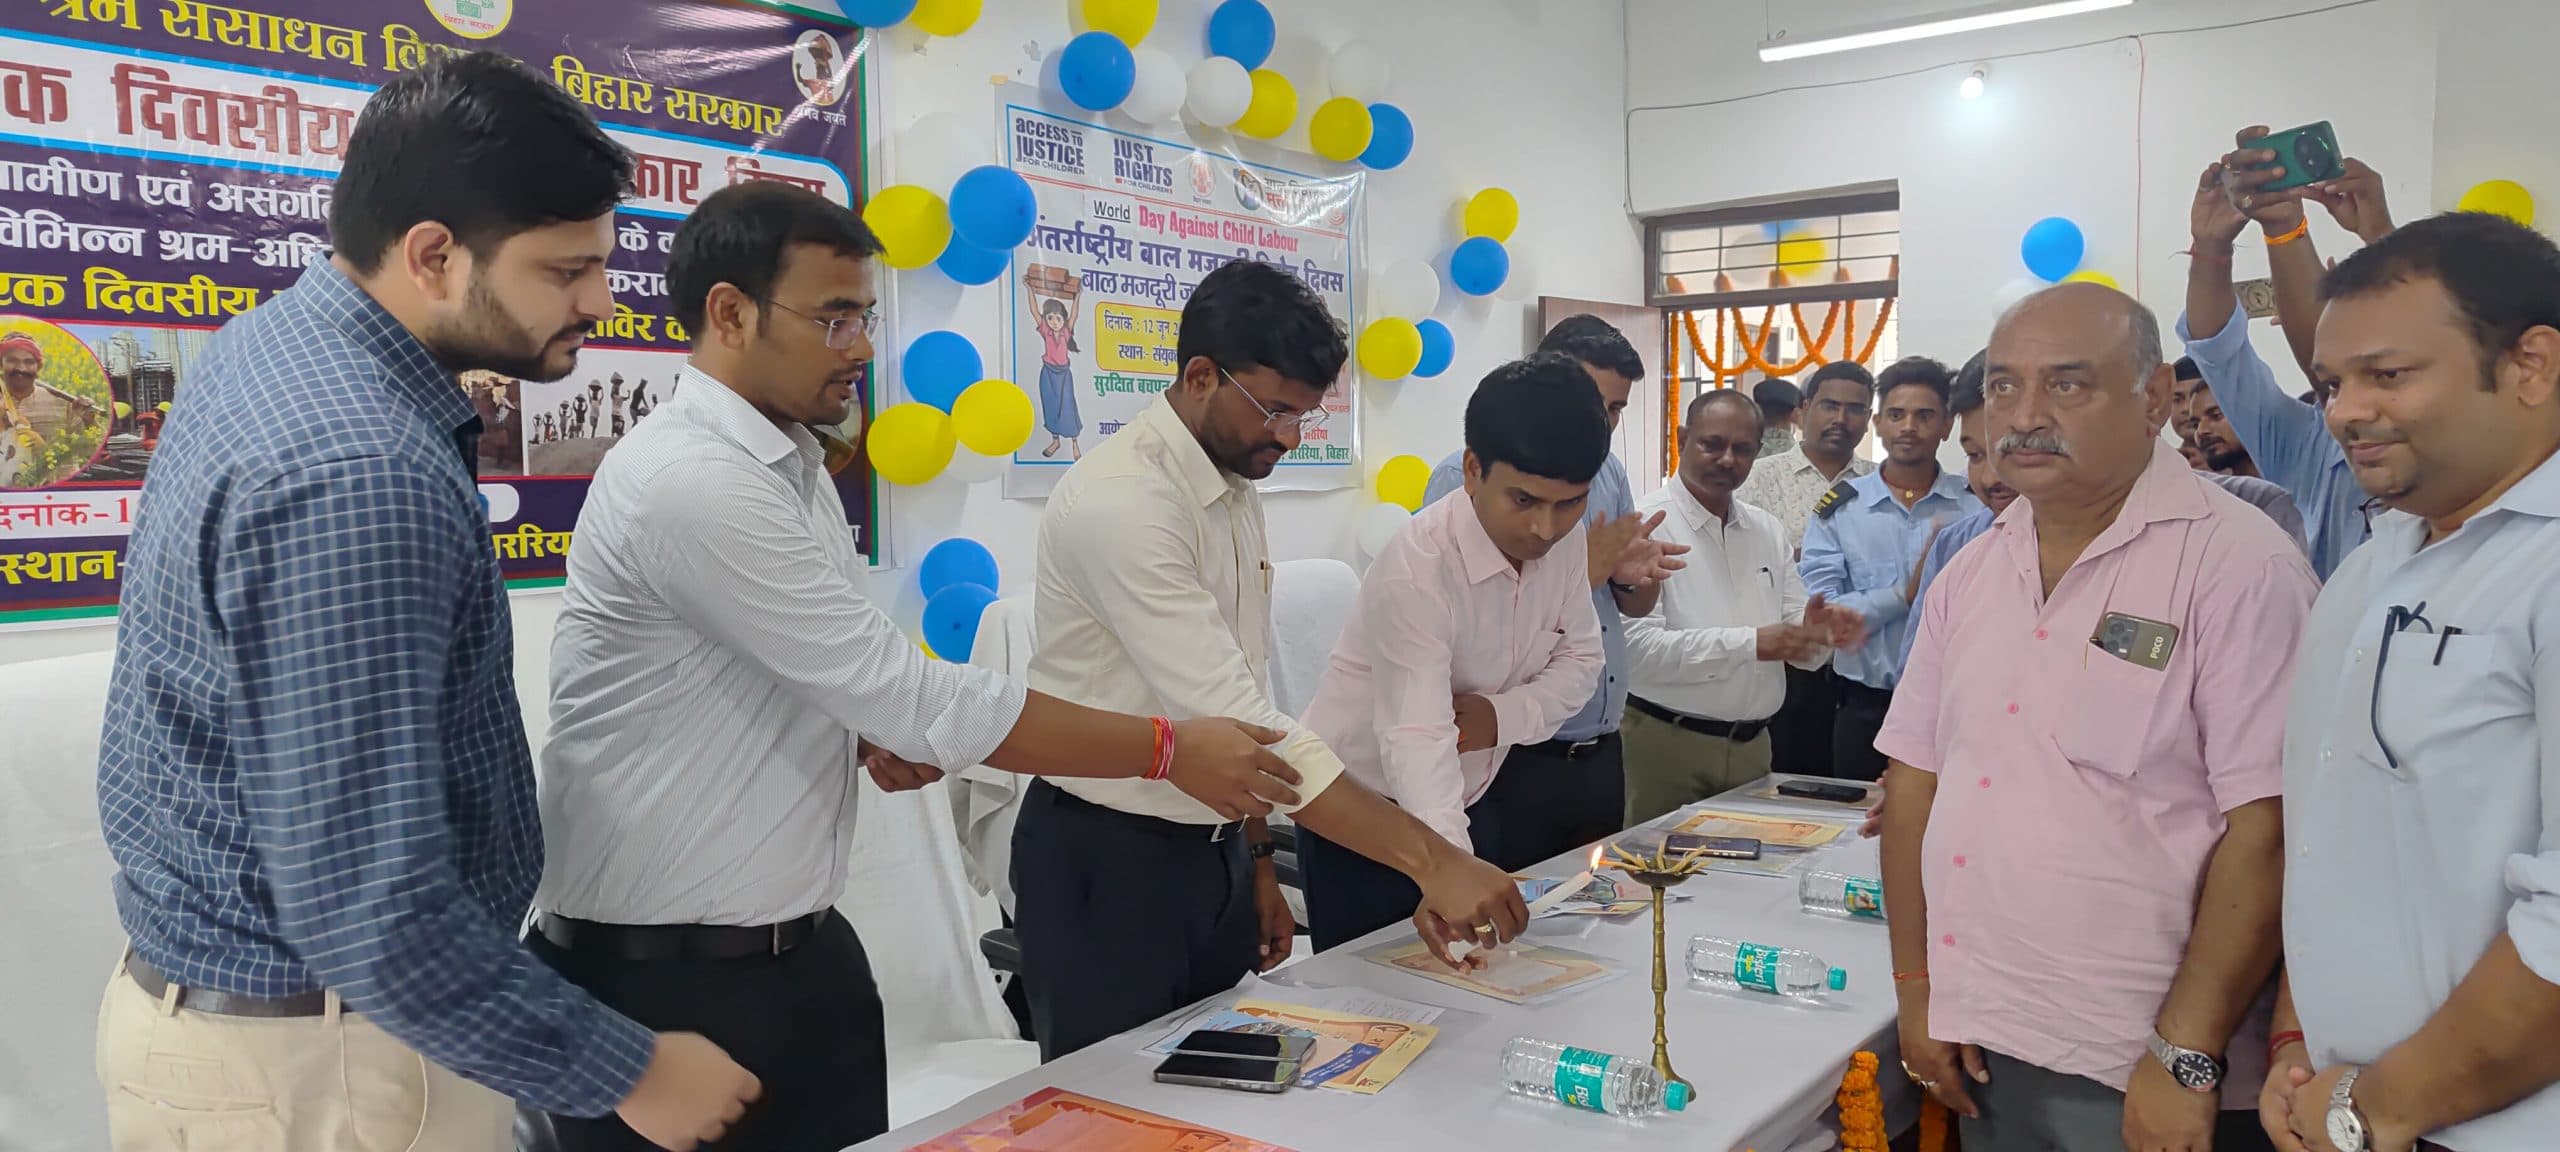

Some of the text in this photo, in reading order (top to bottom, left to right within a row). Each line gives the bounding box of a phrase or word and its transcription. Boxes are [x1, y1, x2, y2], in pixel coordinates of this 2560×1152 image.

[551, 55, 654, 114] बिहार
[664, 86, 784, 137] सरकार
[0, 60, 73, 125] क
[110, 62, 355, 161] दिवसीय
[1016, 134, 1085, 168] JUSTICE
[1071, 135, 1084, 148] TO
[1113, 137, 1154, 163] JUST
[1023, 157, 1085, 176] FOR CHILDREN
[1114, 158, 1173, 187] RIGHTS
[136, 168, 193, 208] एवं
[1124, 178, 1170, 195] FOR CHILDREN
[618, 221, 649, 252] के
[1094, 200, 1299, 253] World Day Against Child Labour
[1140, 242, 1182, 269] बाल
[83, 266, 259, 317] दिवसीय
[1081, 268, 1119, 294] बाल
[1120, 272, 1176, 309] मजदूरी
[1103, 309, 1133, 332] दिनांक
[1143, 319, 1154, 333] 12
[1093, 372, 1135, 397] सुरक्षित
[1325, 444, 1350, 460] बिहार
[2149, 635, 2165, 660] POCO
